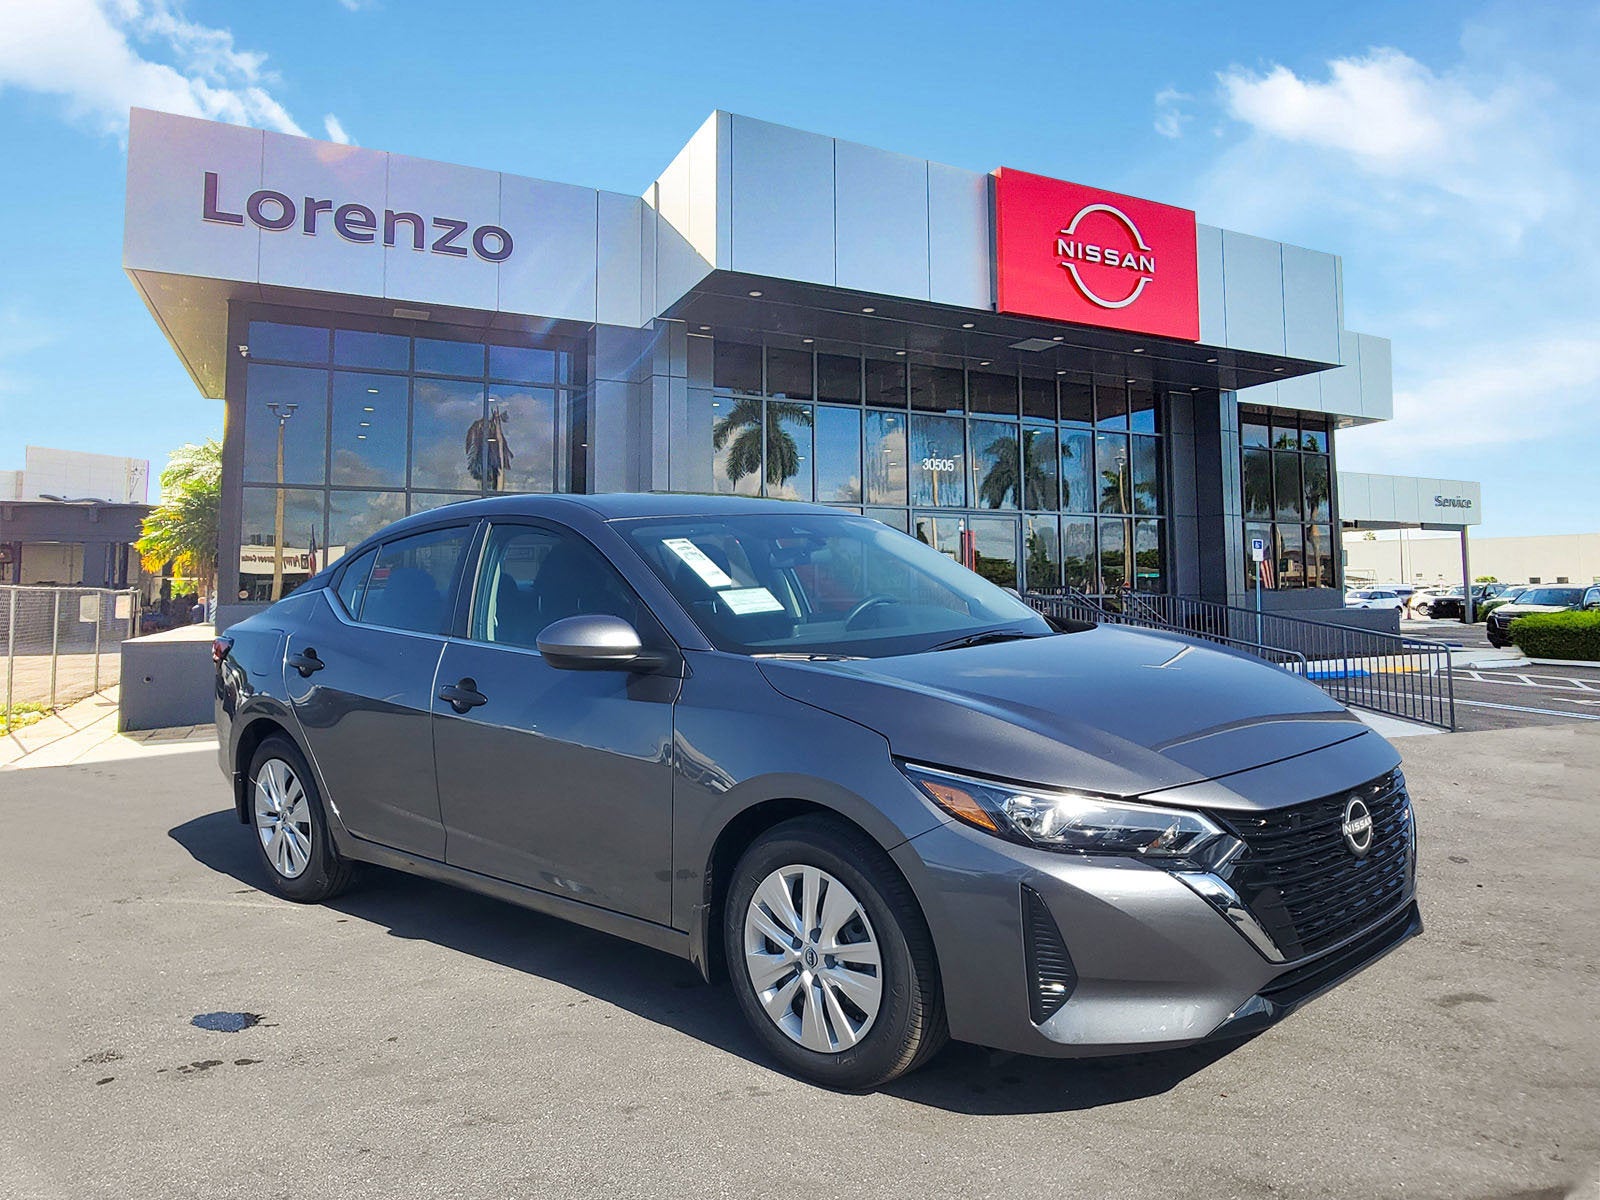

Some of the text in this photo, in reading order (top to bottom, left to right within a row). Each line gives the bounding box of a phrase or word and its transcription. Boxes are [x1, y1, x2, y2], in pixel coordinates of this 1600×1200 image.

[203, 171, 514, 262] Lorenzo
[1058, 238, 1155, 273] NISSAN
[922, 458, 954, 472] 30505
[1434, 495, 1472, 509] Service
[1344, 815, 1372, 833] NISSAN
